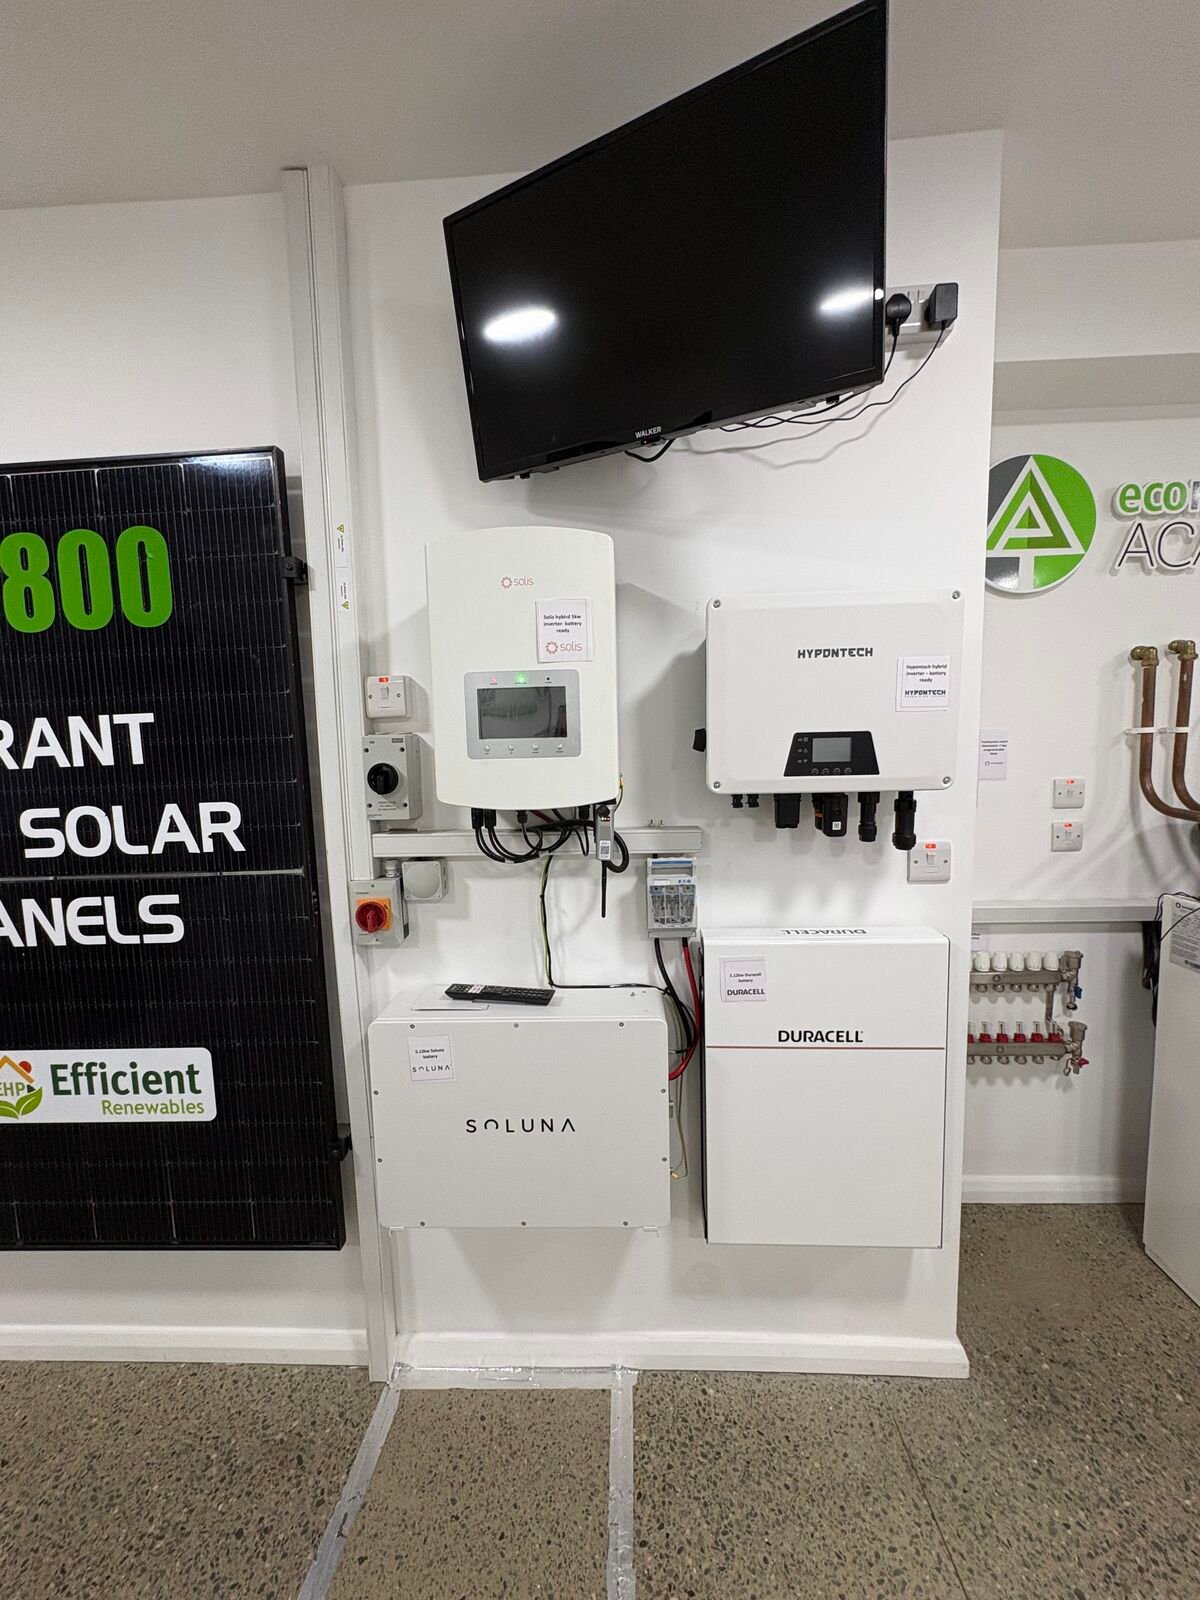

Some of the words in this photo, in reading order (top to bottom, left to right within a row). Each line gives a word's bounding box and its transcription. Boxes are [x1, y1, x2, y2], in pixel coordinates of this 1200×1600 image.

[635, 426, 662, 439] WALKER
[0, 525, 173, 633] 800
[513, 576, 534, 587] solis
[560, 641, 583, 652] solis
[797, 647, 874, 660] HYPONTECH
[19, 801, 247, 859] SOLAR
[727, 988, 766, 996] DURACELL
[778, 1030, 864, 1043] DURACELL
[412, 1064, 451, 1073] SOLUNA
[49, 1061, 203, 1096] Efficient
[101, 1098, 206, 1116] Renewables
[465, 1118, 576, 1134] SOLUNA
